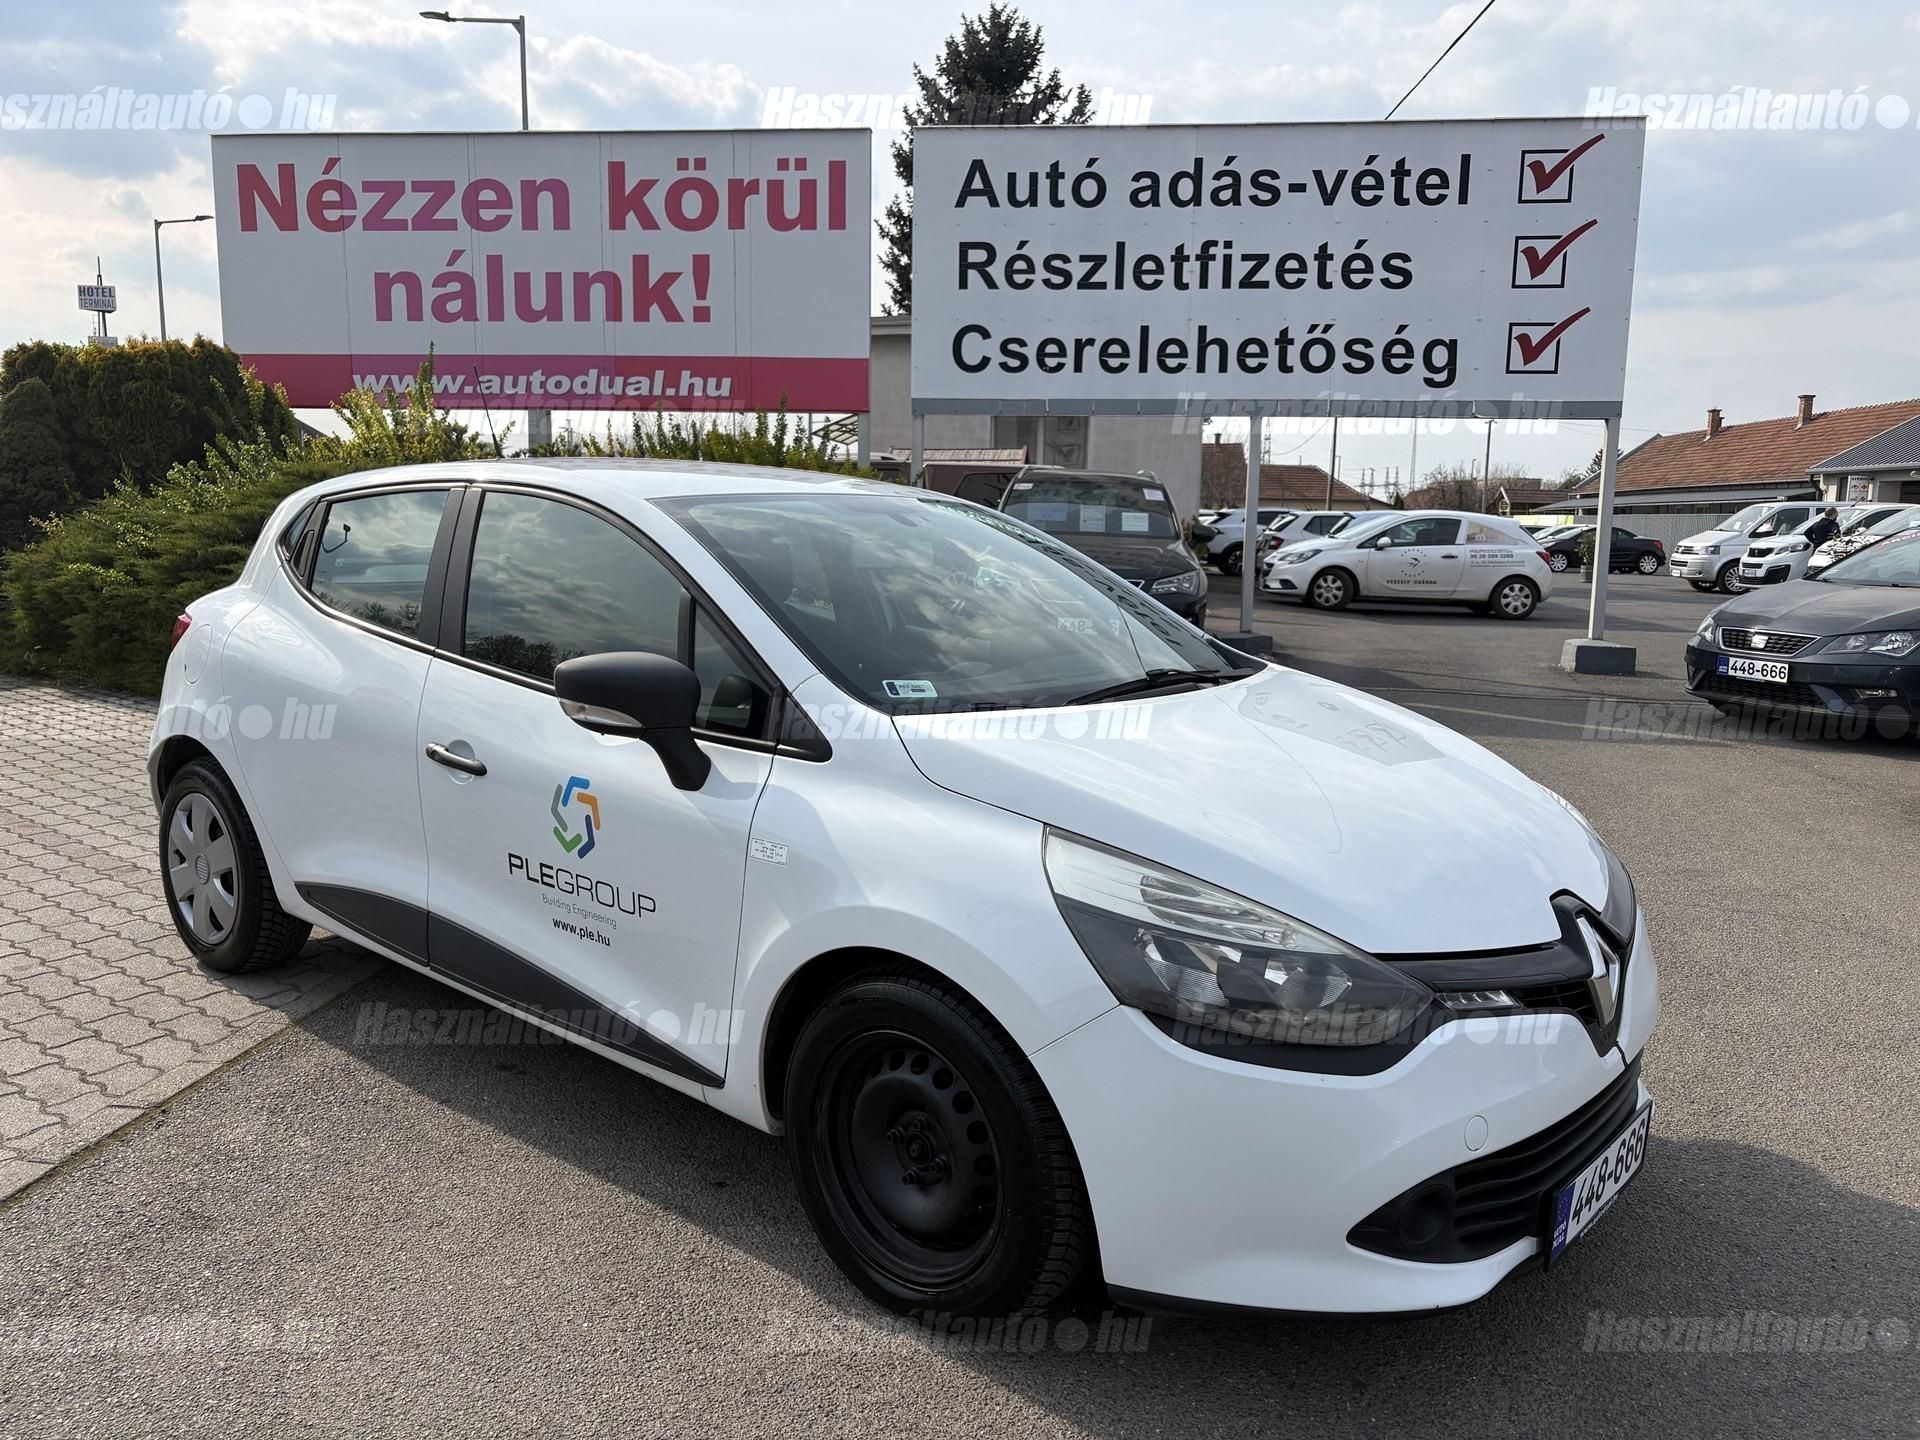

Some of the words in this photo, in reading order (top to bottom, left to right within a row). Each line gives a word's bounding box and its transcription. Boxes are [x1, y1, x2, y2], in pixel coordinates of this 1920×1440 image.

[236, 157, 571, 233] Nézzen
[608, 157, 847, 232] körül
[955, 157, 1108, 209] Autó
[1129, 153, 1472, 209] adás-vétel
[79, 286, 115, 298] HOTEL
[374, 249, 711, 323] nálunk!
[957, 238, 1414, 292] Részletfizetés
[80, 298, 117, 309] TERMINAL
[352, 368, 732, 398] www.autodual.hu
[952, 323, 1460, 389] Cserelehetőség
[1730, 660, 1787, 680] 448-666
[508, 852, 657, 918] PLEGROUP
[542, 893, 572, 915] Building
[573, 903, 617, 930] Engineering
[552, 917, 611, 947] www.ple.hu
[1571, 1117, 1646, 1226] 448-666
